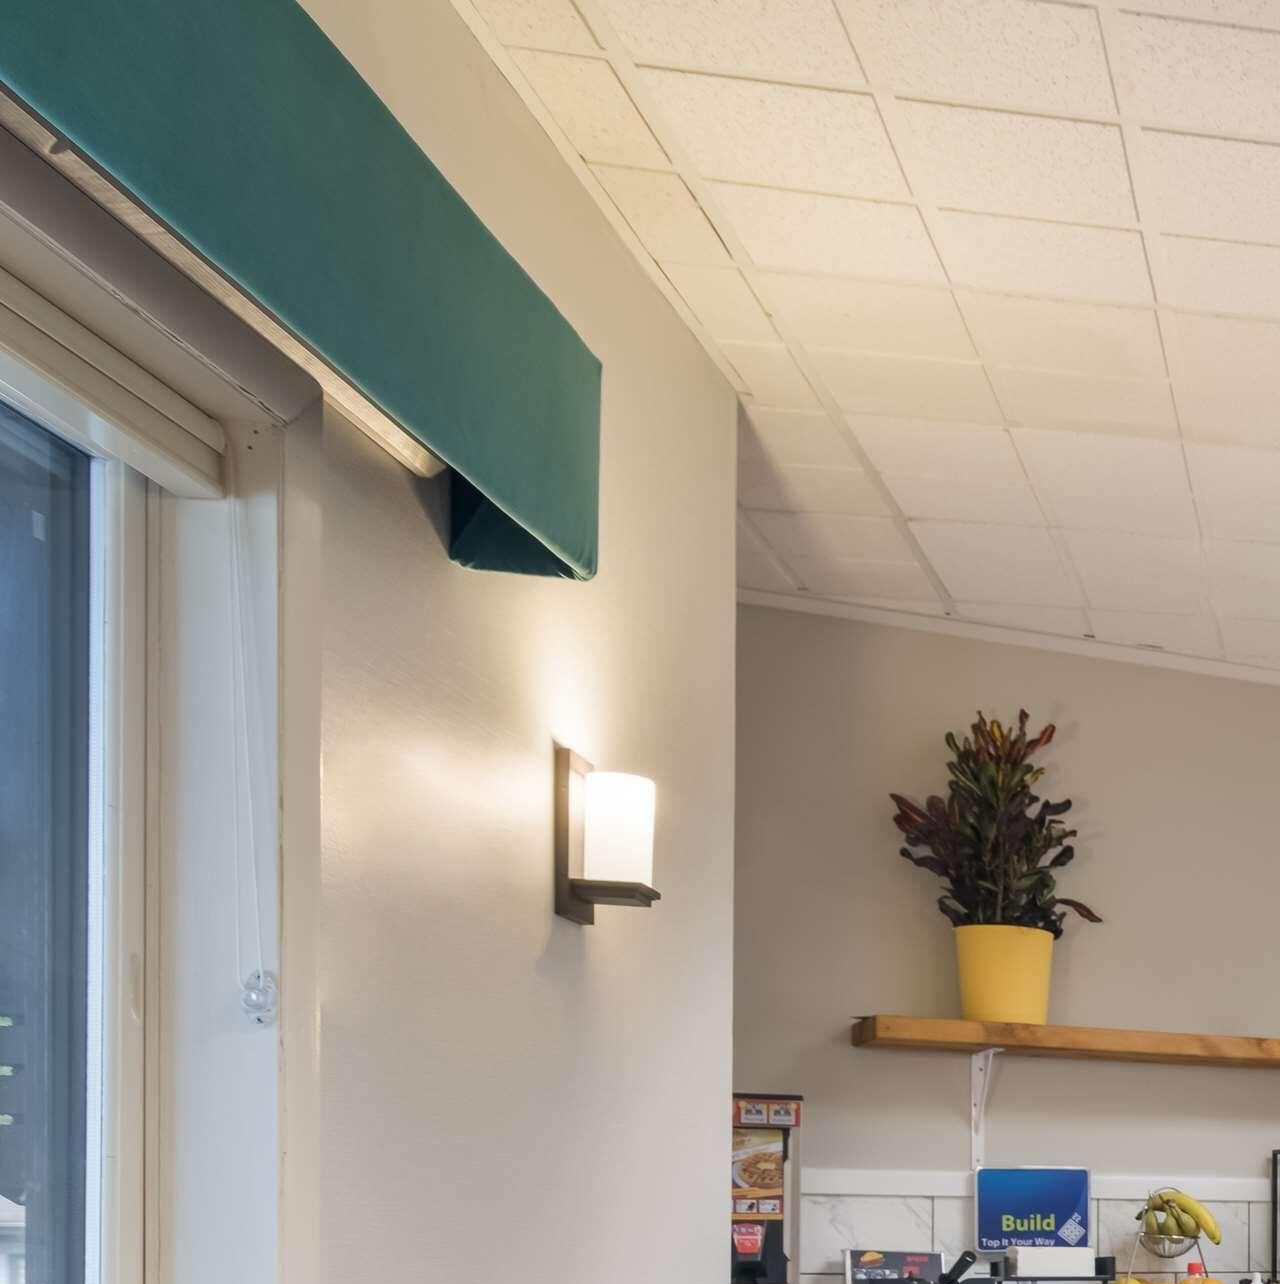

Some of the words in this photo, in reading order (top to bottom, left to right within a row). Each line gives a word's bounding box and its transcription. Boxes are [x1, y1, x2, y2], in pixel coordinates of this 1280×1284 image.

[1001, 1213, 1056, 1232] Build
[981, 1238, 1001, 1248] Top
[1010, 1238, 1033, 1246] Your
[1034, 1237, 1056, 1247] Way
